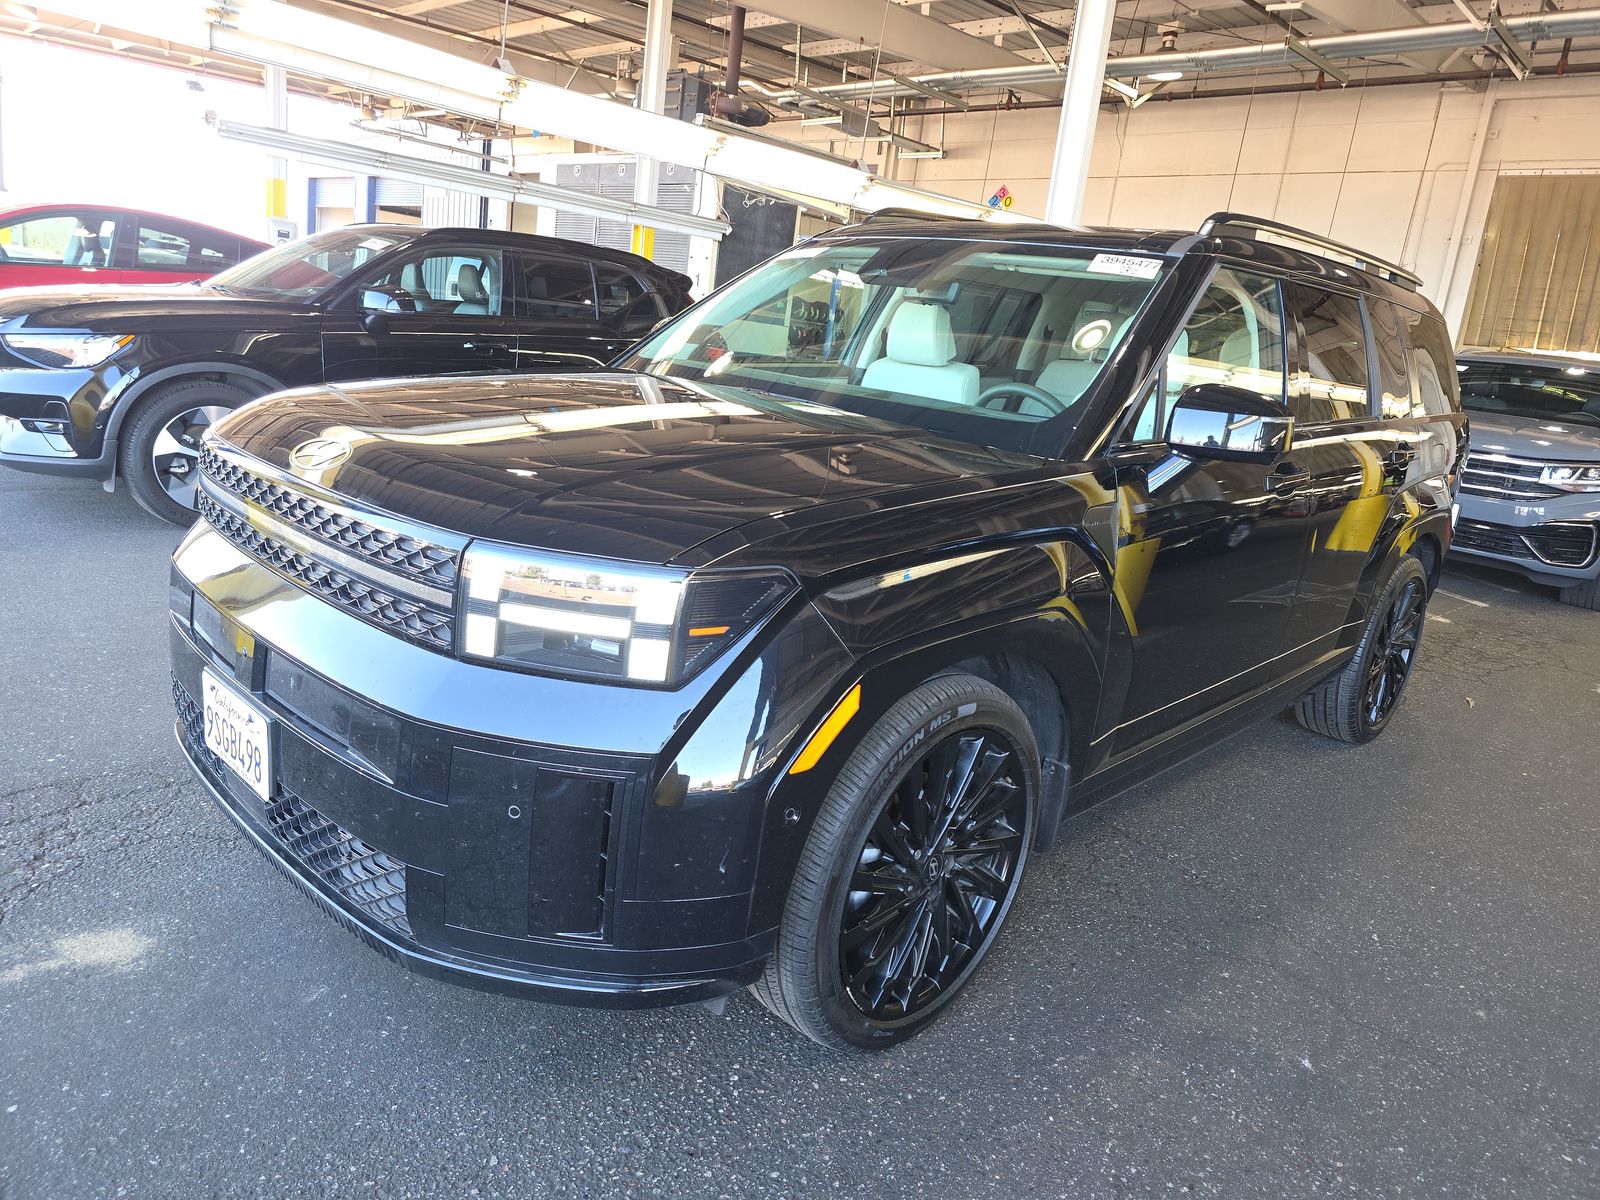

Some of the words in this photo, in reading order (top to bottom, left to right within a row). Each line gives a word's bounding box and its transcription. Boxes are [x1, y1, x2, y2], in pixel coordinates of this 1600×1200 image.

[999, 187, 1006, 199] 3
[990, 195, 998, 206] 2
[1004, 196, 1012, 207] 0
[1100, 255, 1162, 270] 3945477
[929, 710, 952, 732] MS
[206, 704, 262, 784] 9SGB498
